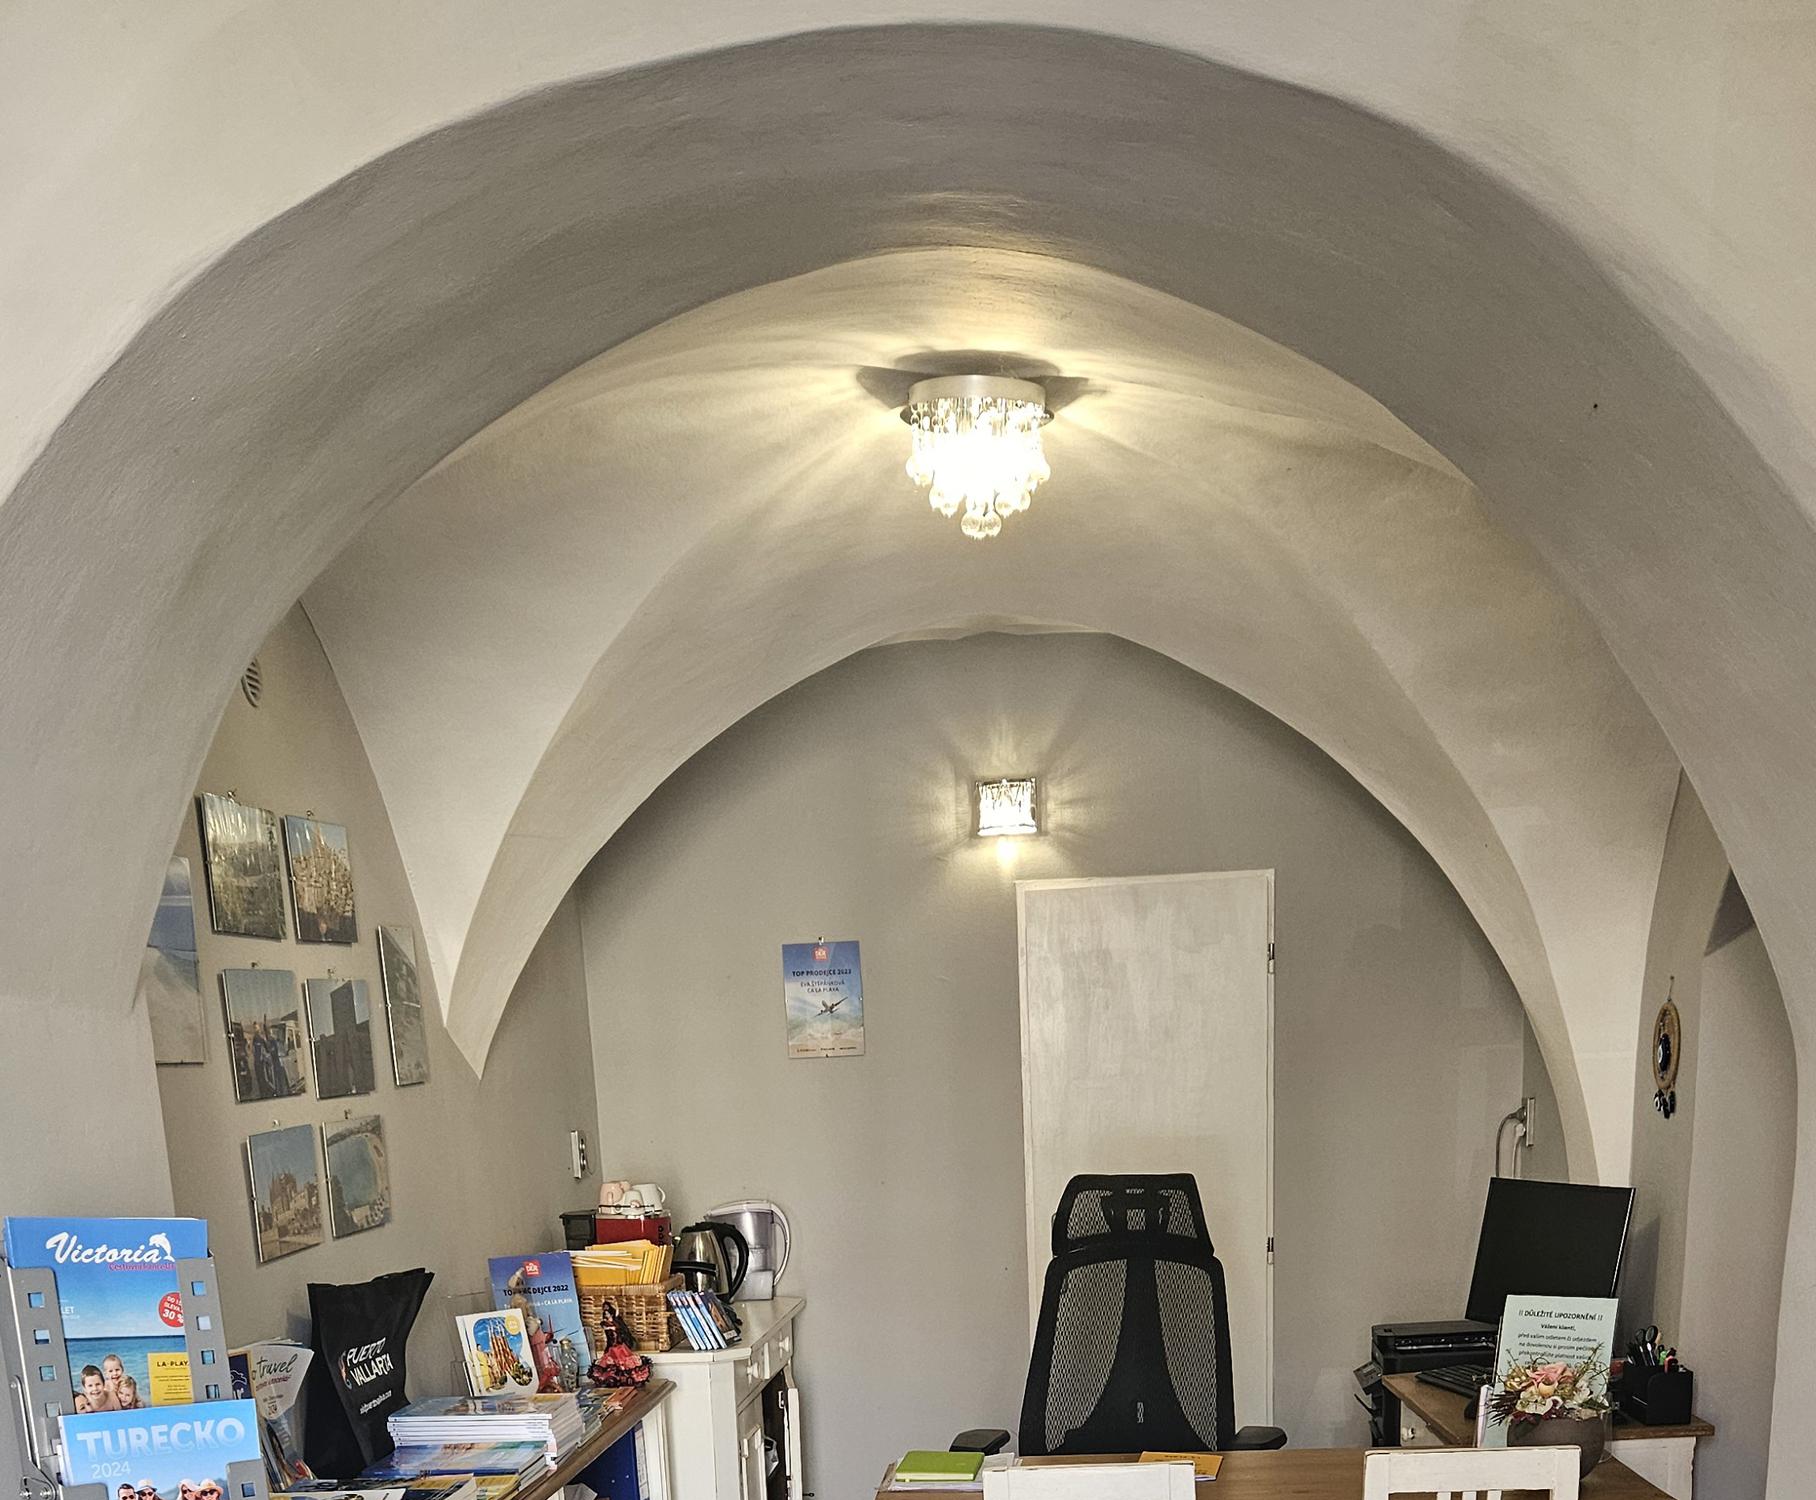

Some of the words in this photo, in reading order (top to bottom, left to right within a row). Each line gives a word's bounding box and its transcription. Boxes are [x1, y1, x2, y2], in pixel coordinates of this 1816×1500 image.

[806, 969, 836, 977] PRODEJCE
[46, 1231, 162, 1264] Victoria
[552, 1284, 569, 1292] 2022
[163, 1308, 176, 1320] 30
[1524, 1309, 1553, 1319] DŮLEŽITÉ
[1554, 1312, 1597, 1321] UPOZORNĚNÍ
[346, 1336, 387, 1367] PUERTO
[350, 1352, 394, 1387] VALLARTA
[76, 1417, 246, 1461] TURECKO
[91, 1460, 132, 1480] 2024
